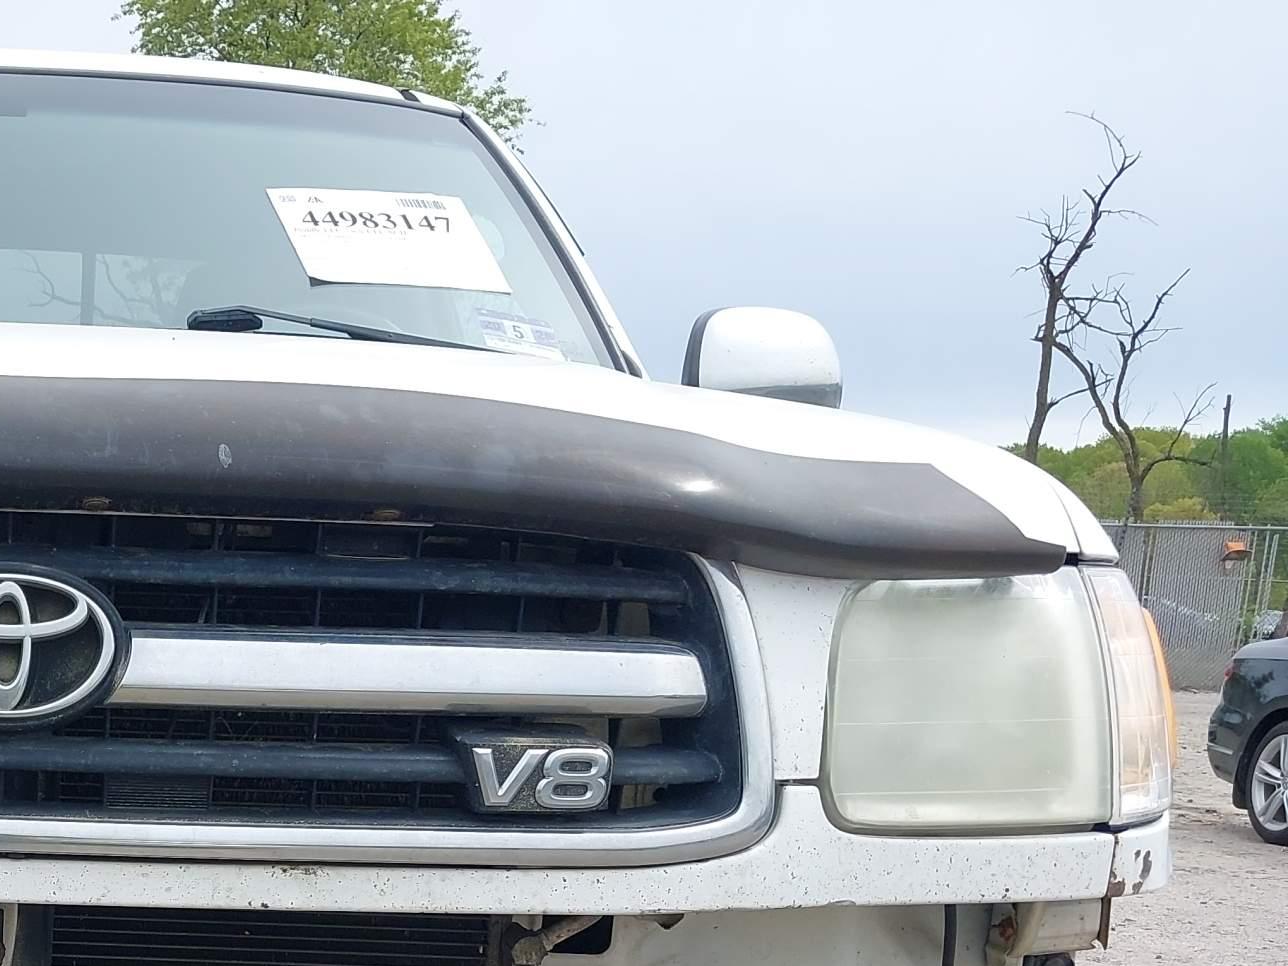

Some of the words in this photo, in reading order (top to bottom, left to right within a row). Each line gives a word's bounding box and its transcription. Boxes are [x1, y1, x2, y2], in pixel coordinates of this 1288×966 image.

[302, 209, 450, 233] 44983147
[511, 324, 525, 340] 5
[472, 747, 610, 809] V8
